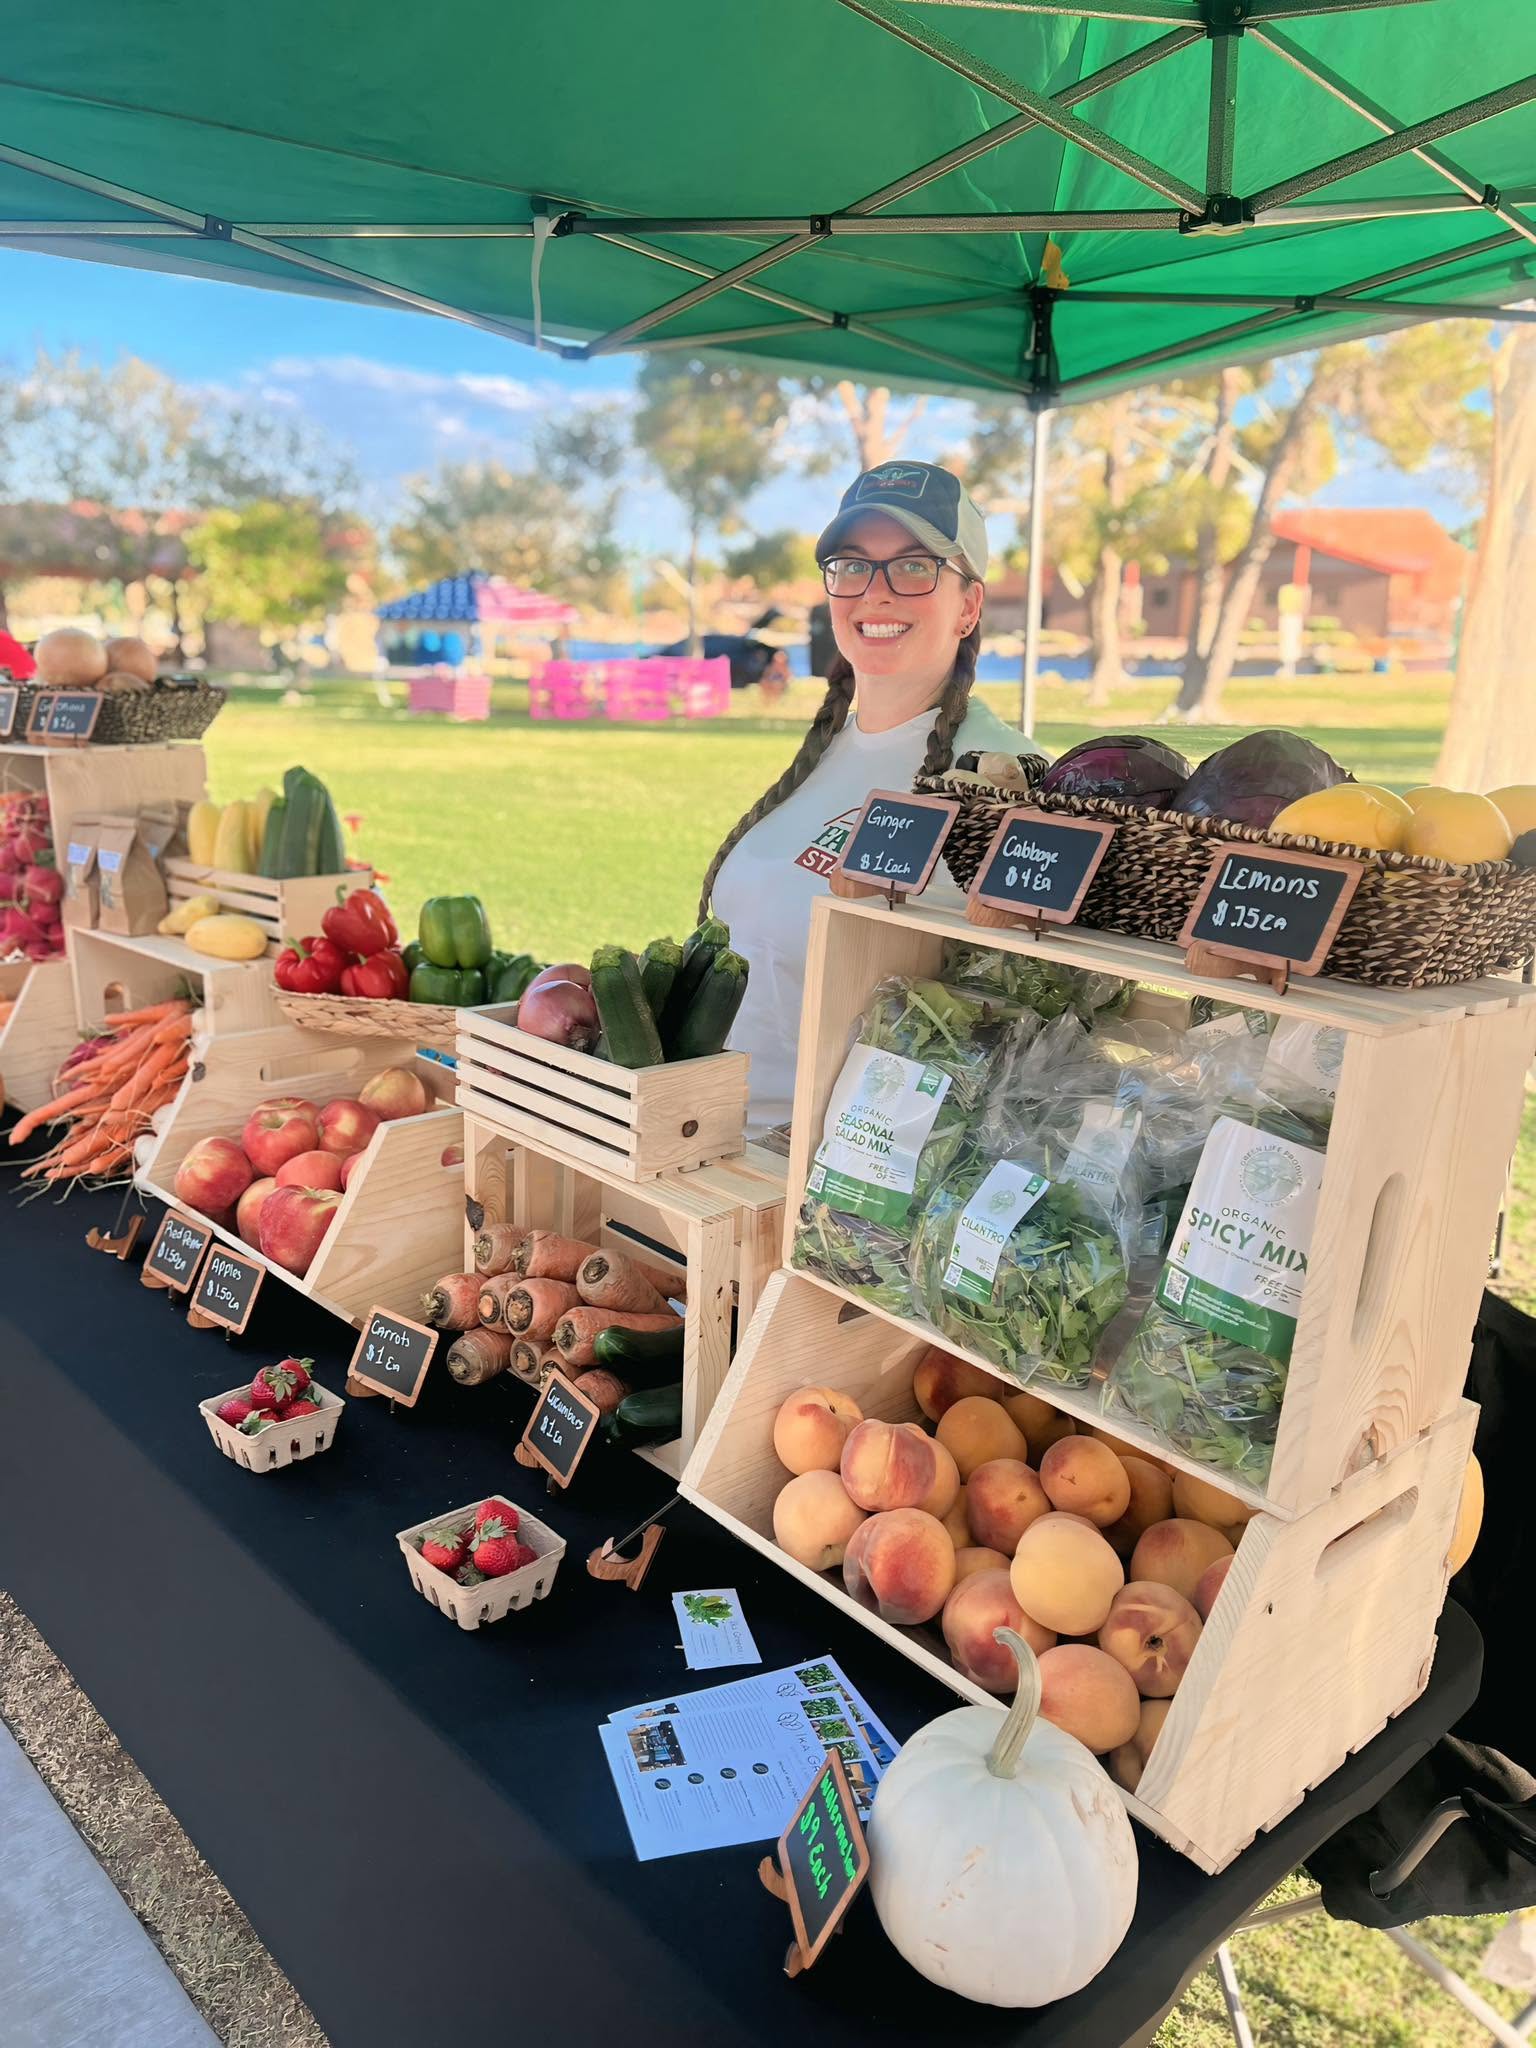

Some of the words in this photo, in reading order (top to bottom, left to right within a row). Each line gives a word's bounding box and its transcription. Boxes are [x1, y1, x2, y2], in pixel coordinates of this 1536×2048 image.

[867, 806, 914, 839] Ginger
[1002, 835, 1059, 872] Cabbage
[838, 1112, 895, 1142] SEASONAL
[850, 1104, 893, 1127] ORGANIC
[835, 1125, 866, 1146] SALAD
[867, 1138, 893, 1156] MIX
[868, 1162, 890, 1174] FREE
[961, 1216, 1005, 1244] CILANTRO
[1221, 1207, 1287, 1240] ORGANIC
[1188, 1207, 1256, 1250] SPICY
[1259, 1240, 1309, 1277] MIX
[211, 1257, 242, 1280] Apples
[1254, 1274, 1283, 1290] FREE
[370, 1319, 410, 1348] Carrots
